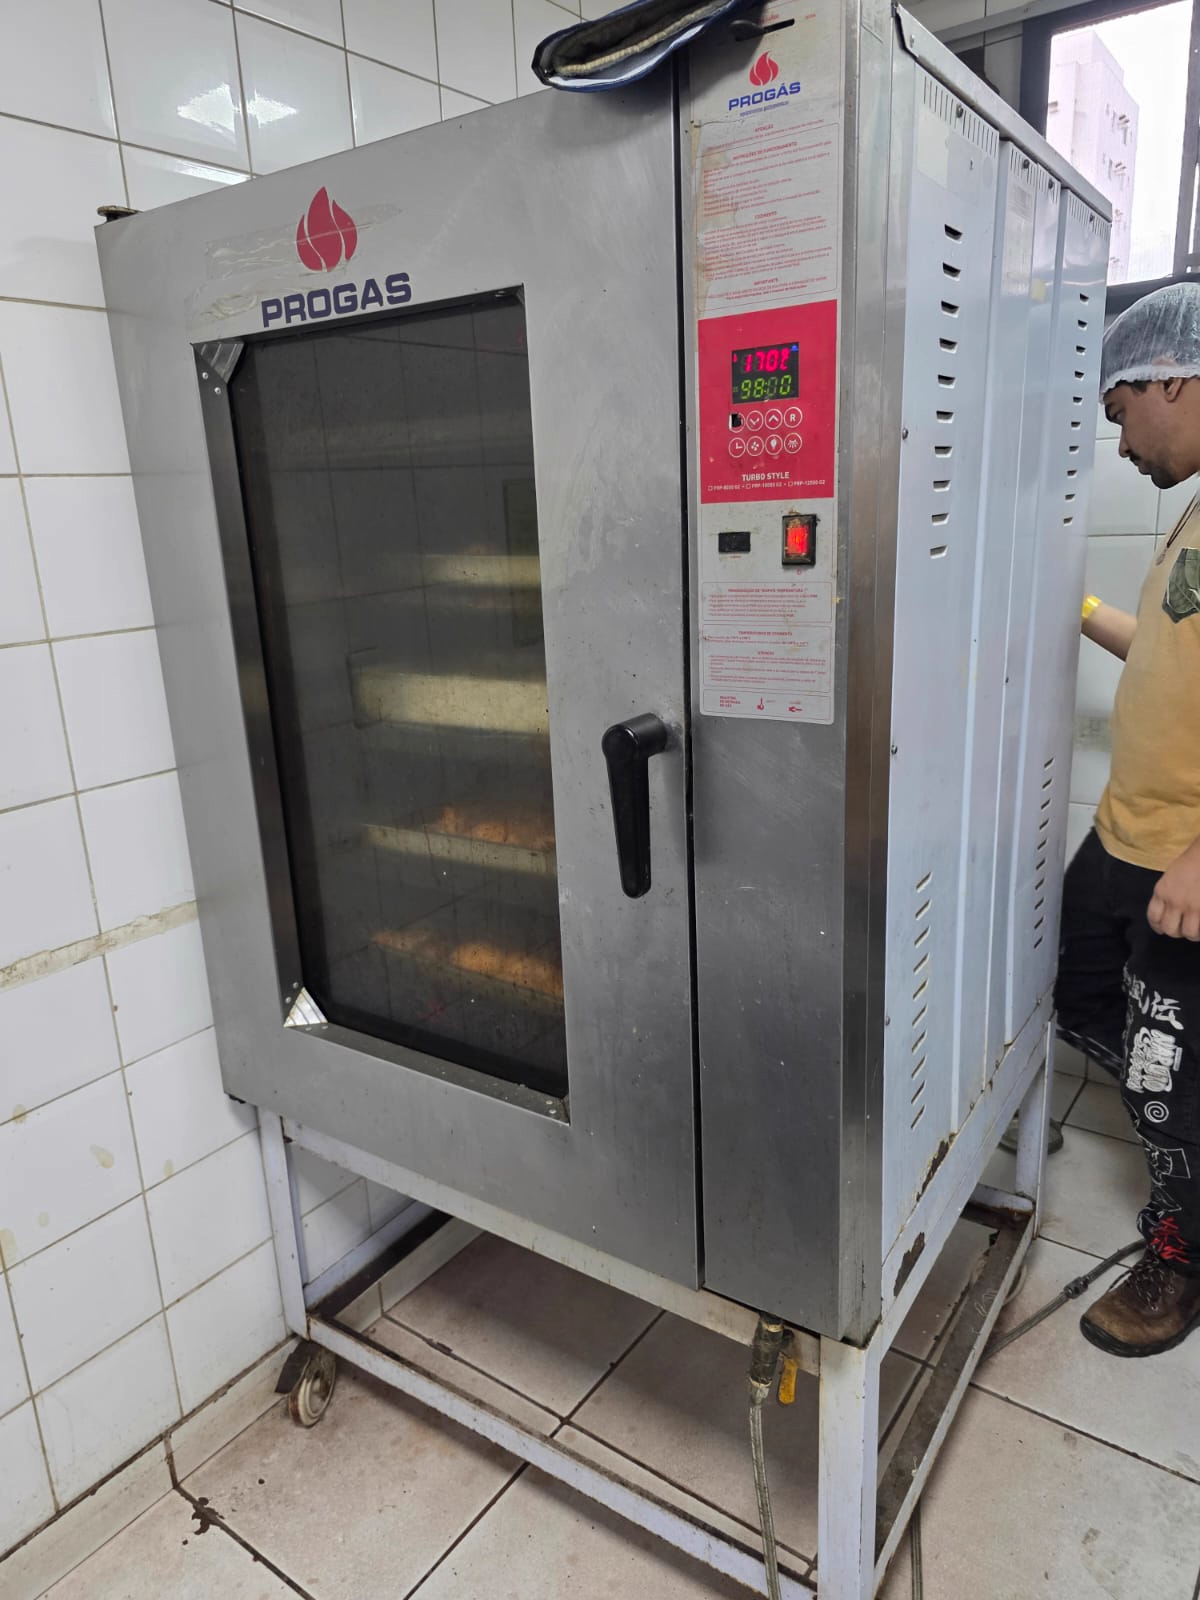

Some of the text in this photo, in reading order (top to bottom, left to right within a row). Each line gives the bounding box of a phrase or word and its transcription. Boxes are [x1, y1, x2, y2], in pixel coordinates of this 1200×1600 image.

[728, 82, 801, 112] PROGÁS
[261, 272, 412, 327] PROGAS
[790, 414, 796, 422] R
[742, 471, 790, 482] TURBO STYLE
